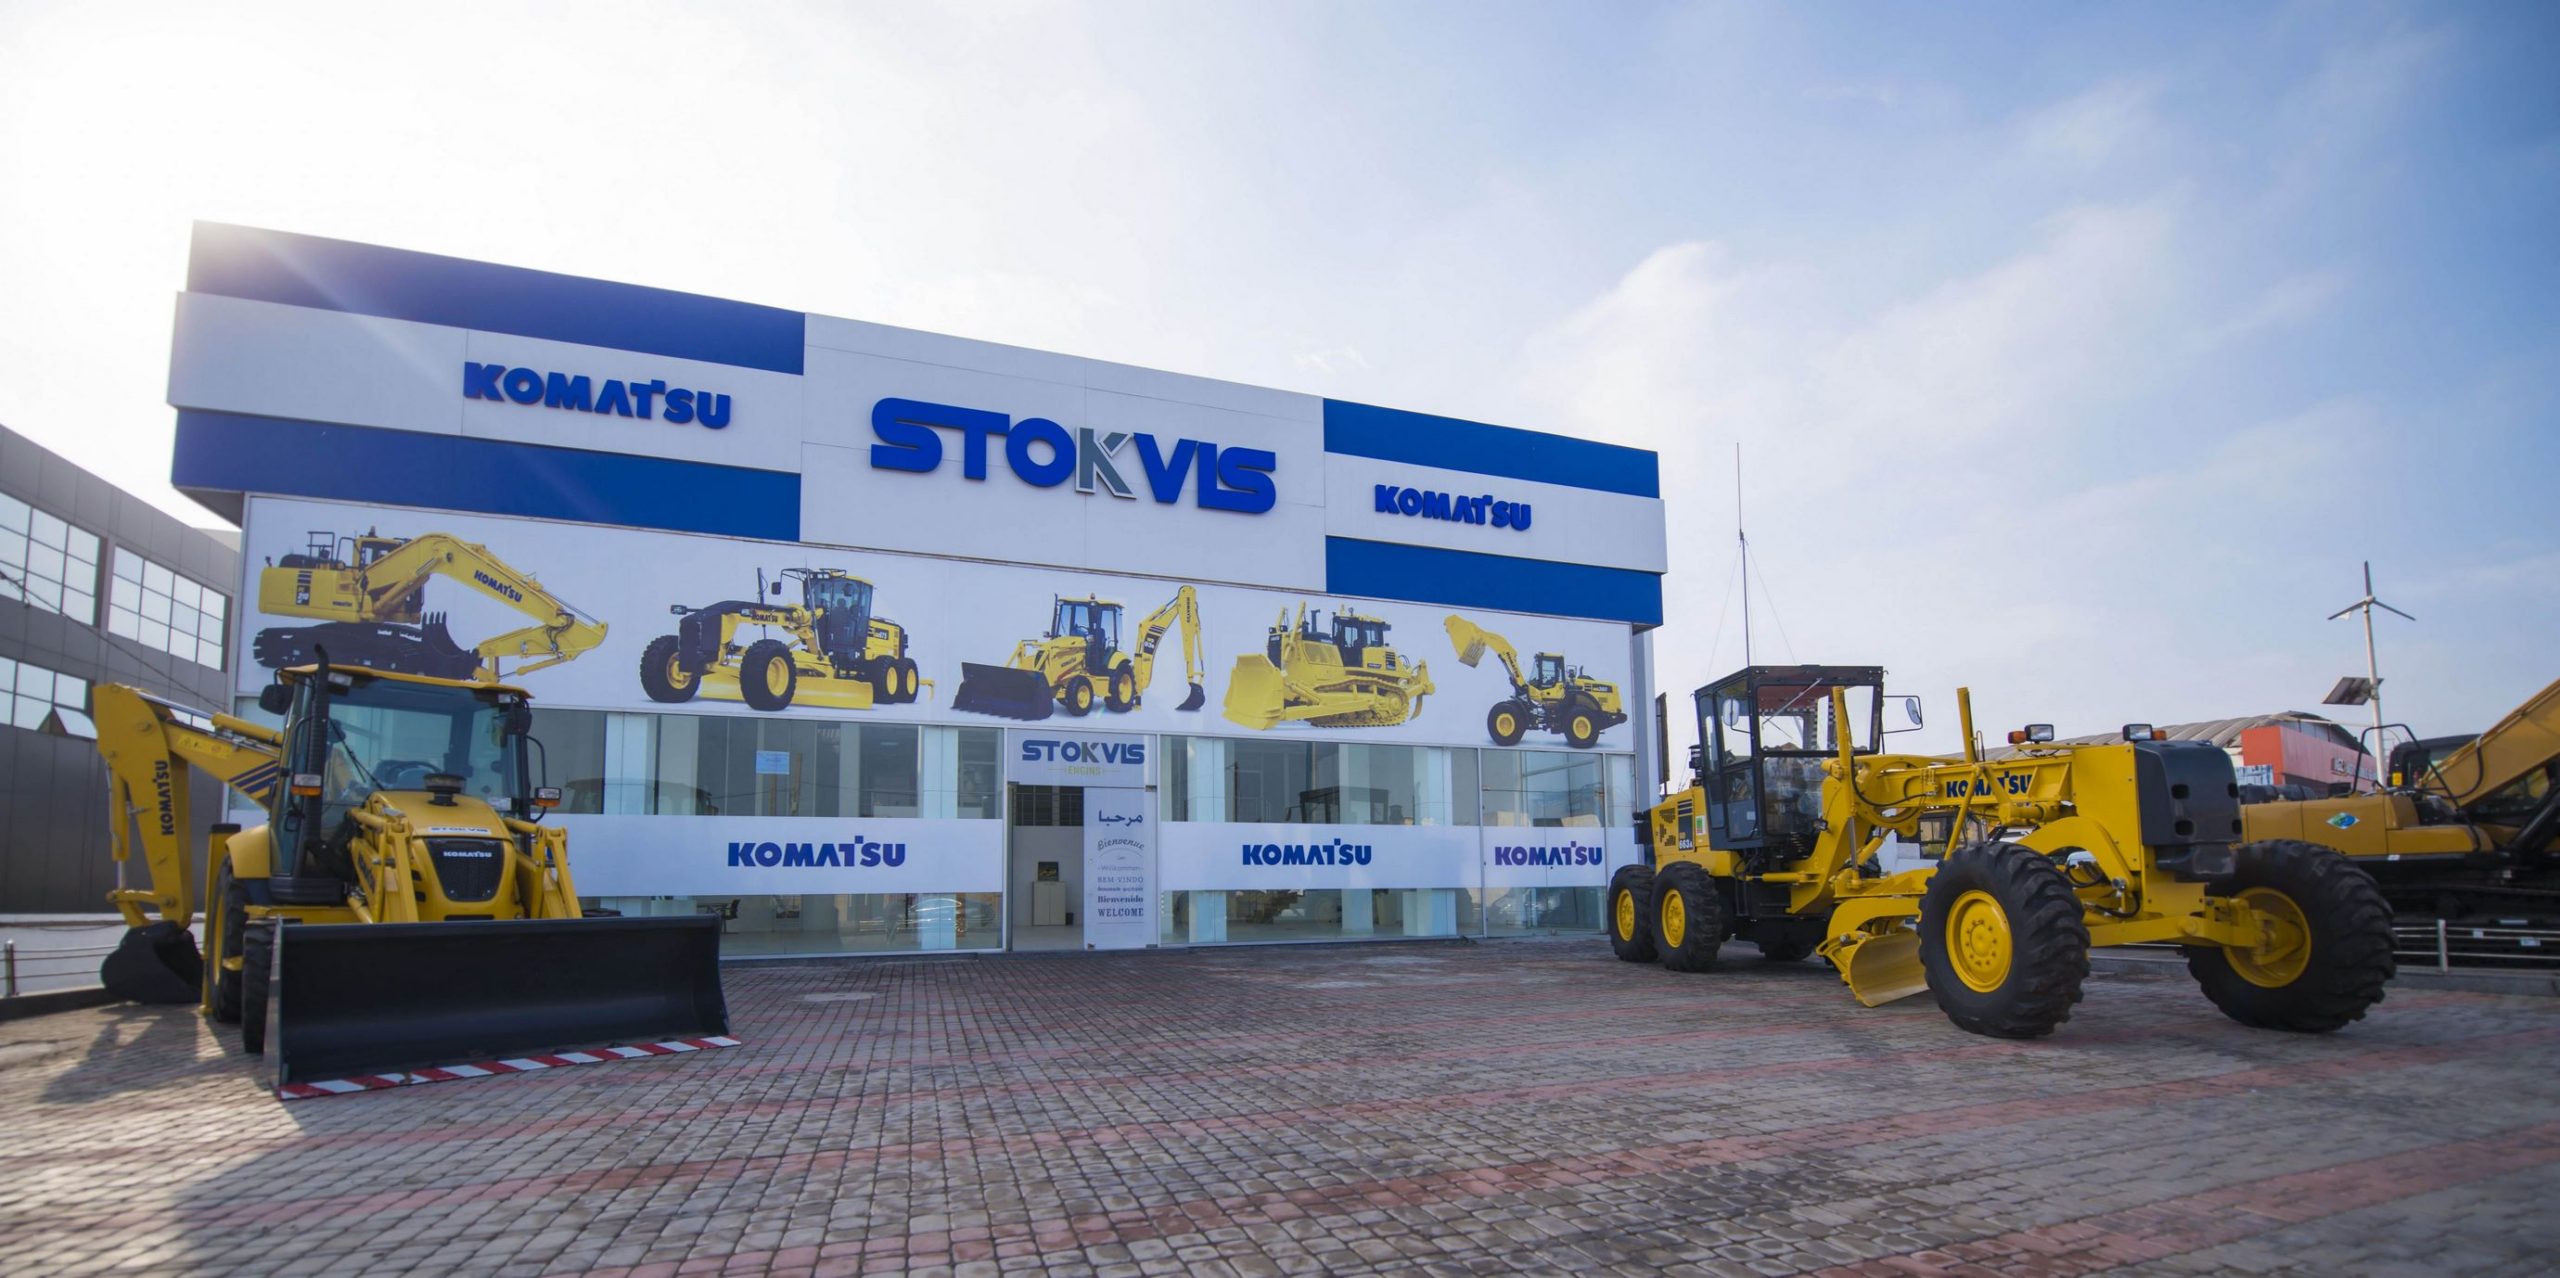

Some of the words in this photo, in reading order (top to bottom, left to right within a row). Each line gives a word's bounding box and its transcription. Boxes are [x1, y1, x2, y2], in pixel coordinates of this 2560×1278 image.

[464, 361, 731, 430] KOMATSU
[868, 397, 1277, 515] STOKVIS
[1374, 484, 1532, 532] KOMATSU
[474, 569, 523, 604] KOMATSU
[1022, 740, 1145, 766] STOKVIS
[1067, 766, 1101, 776] ENGINS
[153, 760, 175, 836] KOMATSU
[1098, 809, 1144, 828] مرحبا
[442, 850, 493, 858] KOMATSU
[728, 836, 906, 867] KOMATSU
[1097, 838, 1145, 851] Bienvenue
[1242, 838, 1373, 867] KOMATSU
[1495, 841, 1603, 867] KOMATSU
[1097, 895, 1144, 903] Bienvenido
[1097, 907, 1145, 917] WELCOME
